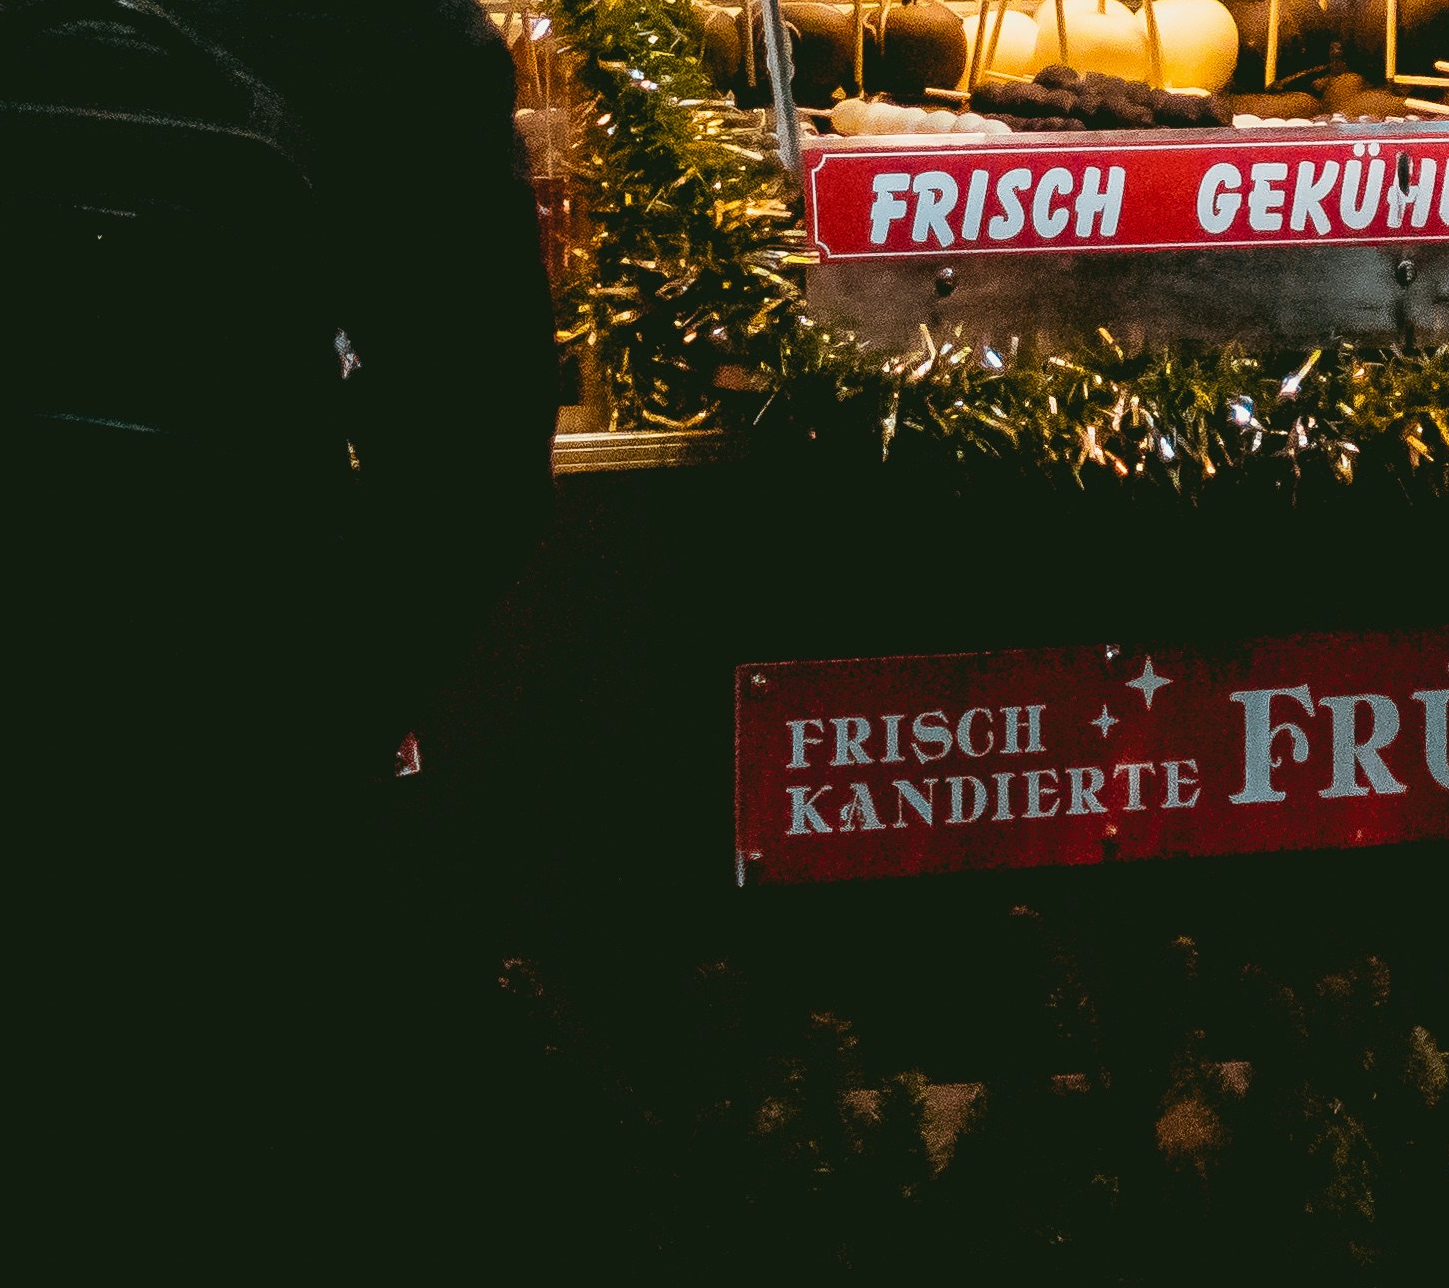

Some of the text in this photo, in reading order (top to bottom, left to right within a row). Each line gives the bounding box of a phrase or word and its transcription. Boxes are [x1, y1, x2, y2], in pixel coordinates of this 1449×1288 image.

[869, 166, 1127, 249] FRISCH
[783, 703, 1049, 771] FRISCH
[783, 757, 1203, 839] KANDIERTE
